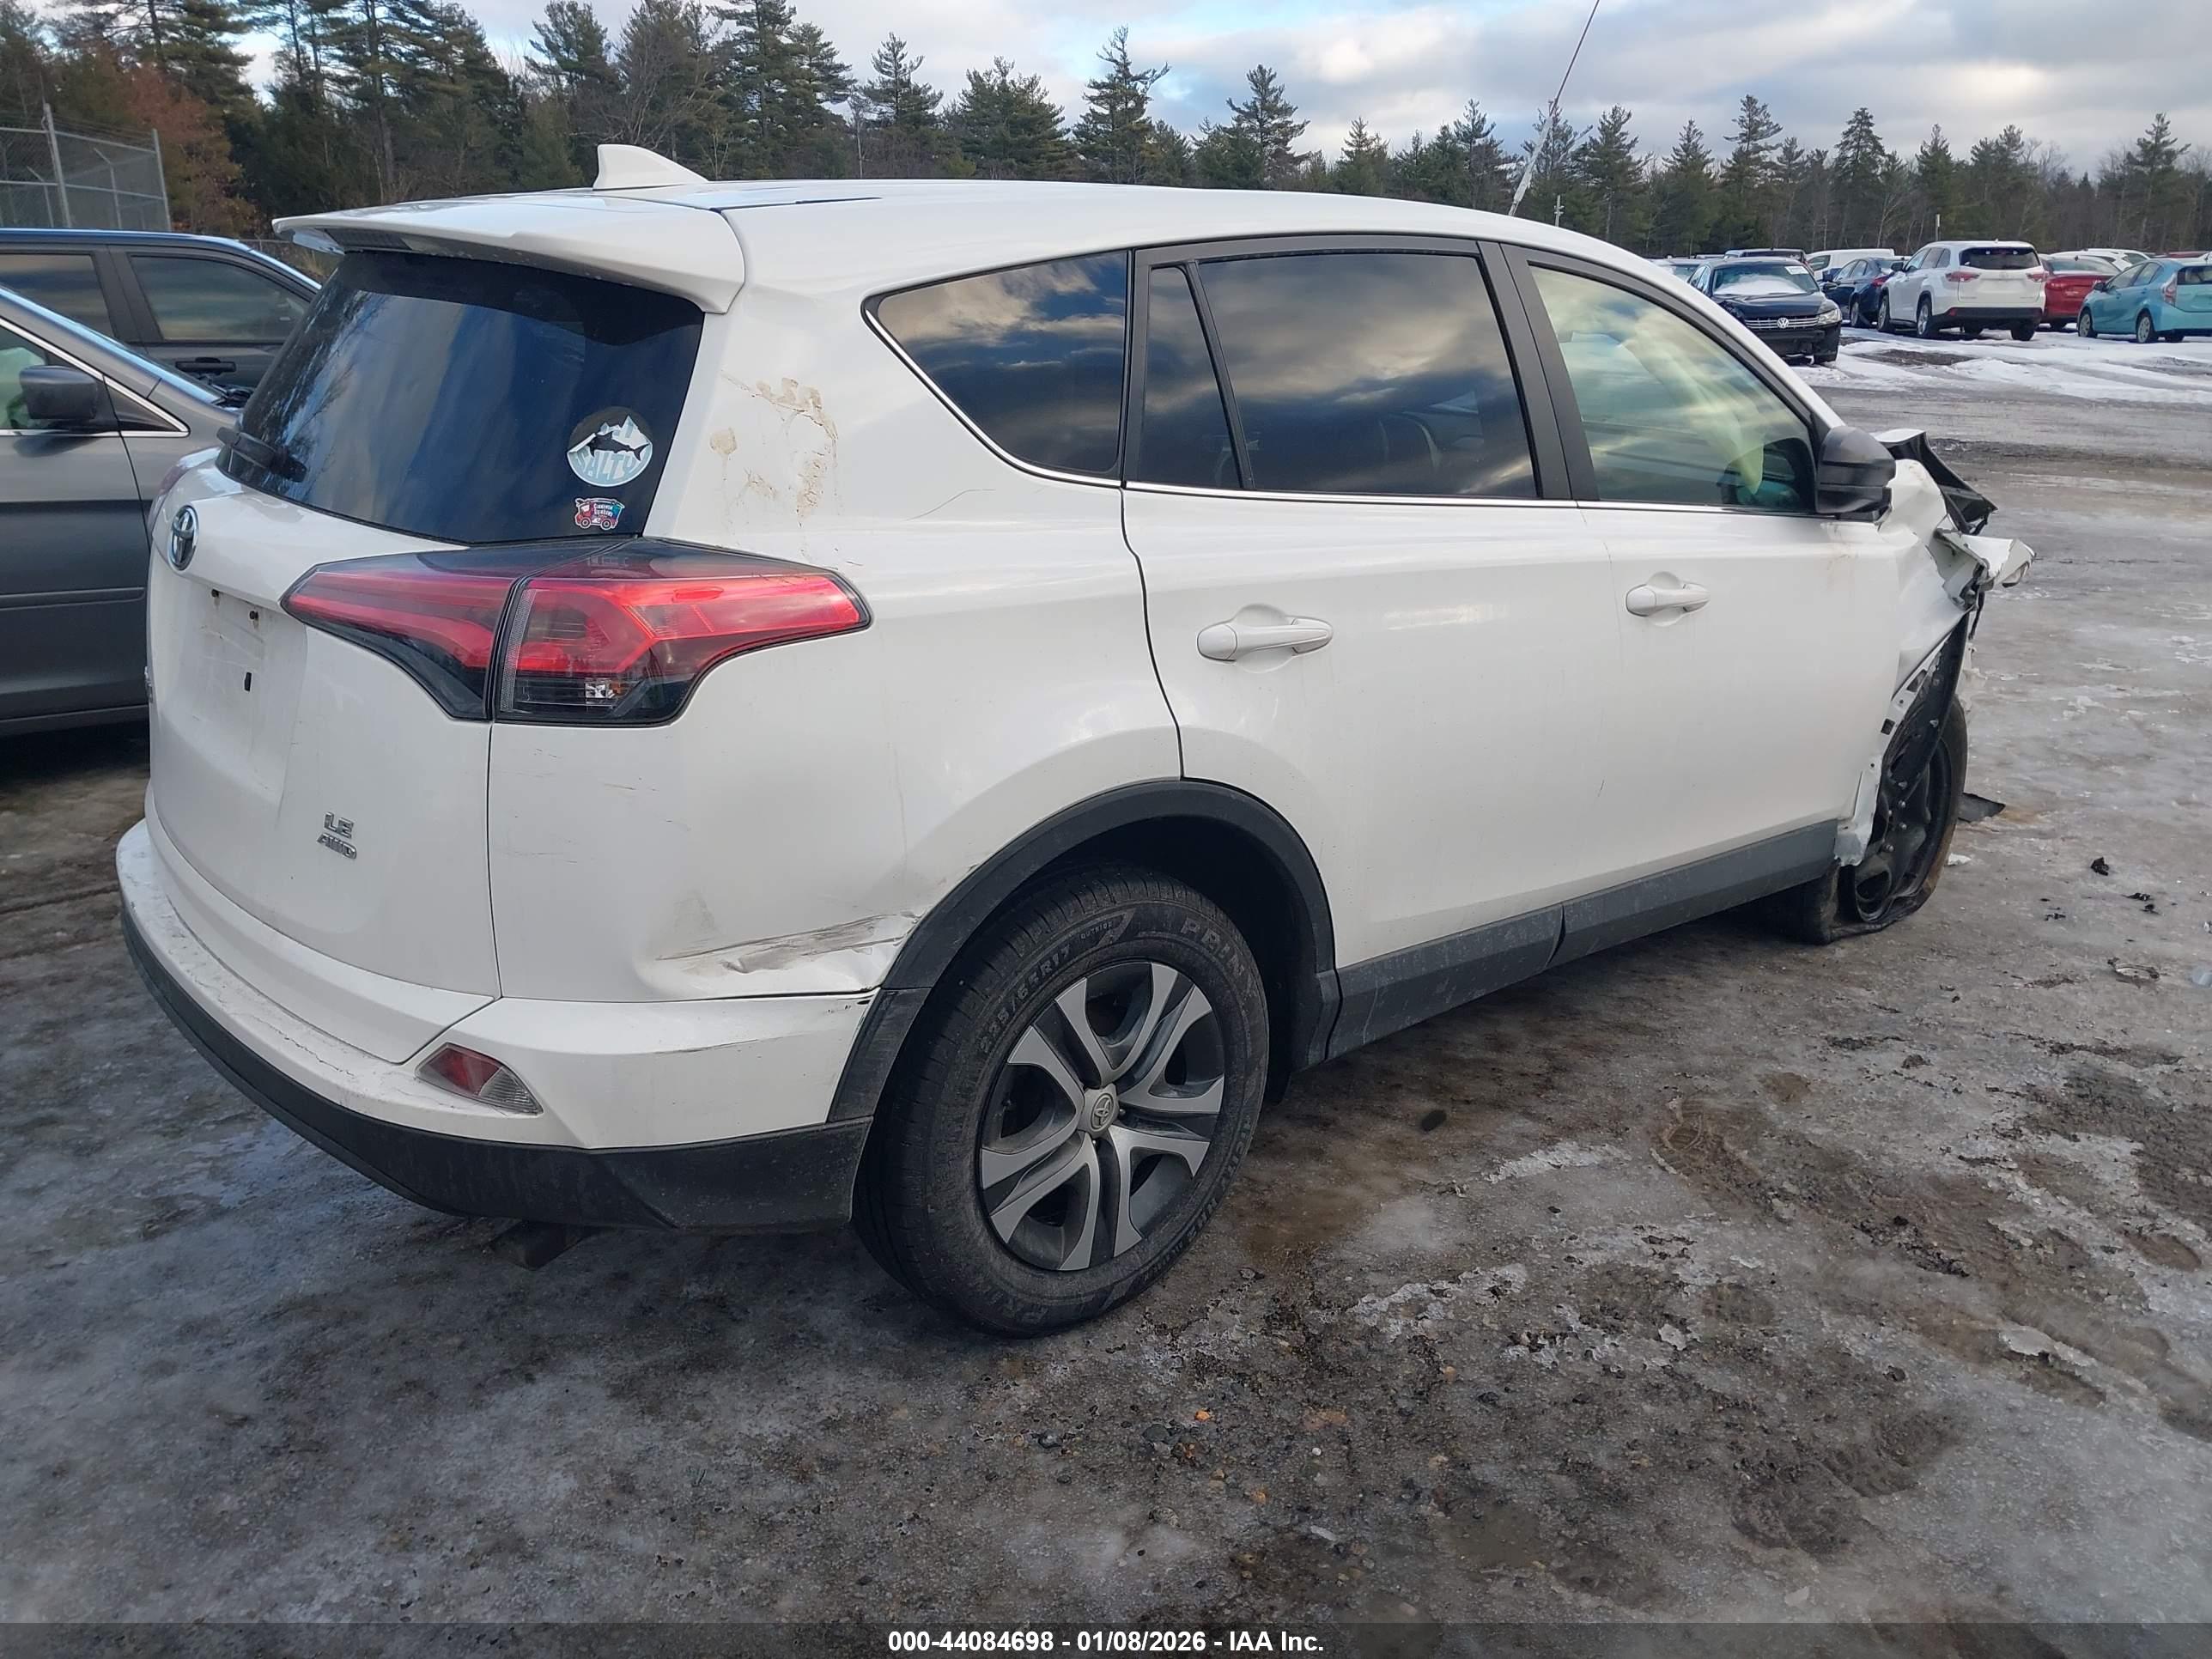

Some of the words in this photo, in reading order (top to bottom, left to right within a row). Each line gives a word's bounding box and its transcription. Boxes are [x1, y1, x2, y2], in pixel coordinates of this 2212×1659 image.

[574, 449, 639, 482] SALTY
[324, 811, 355, 840] LE
[316, 832, 357, 860] AWD
